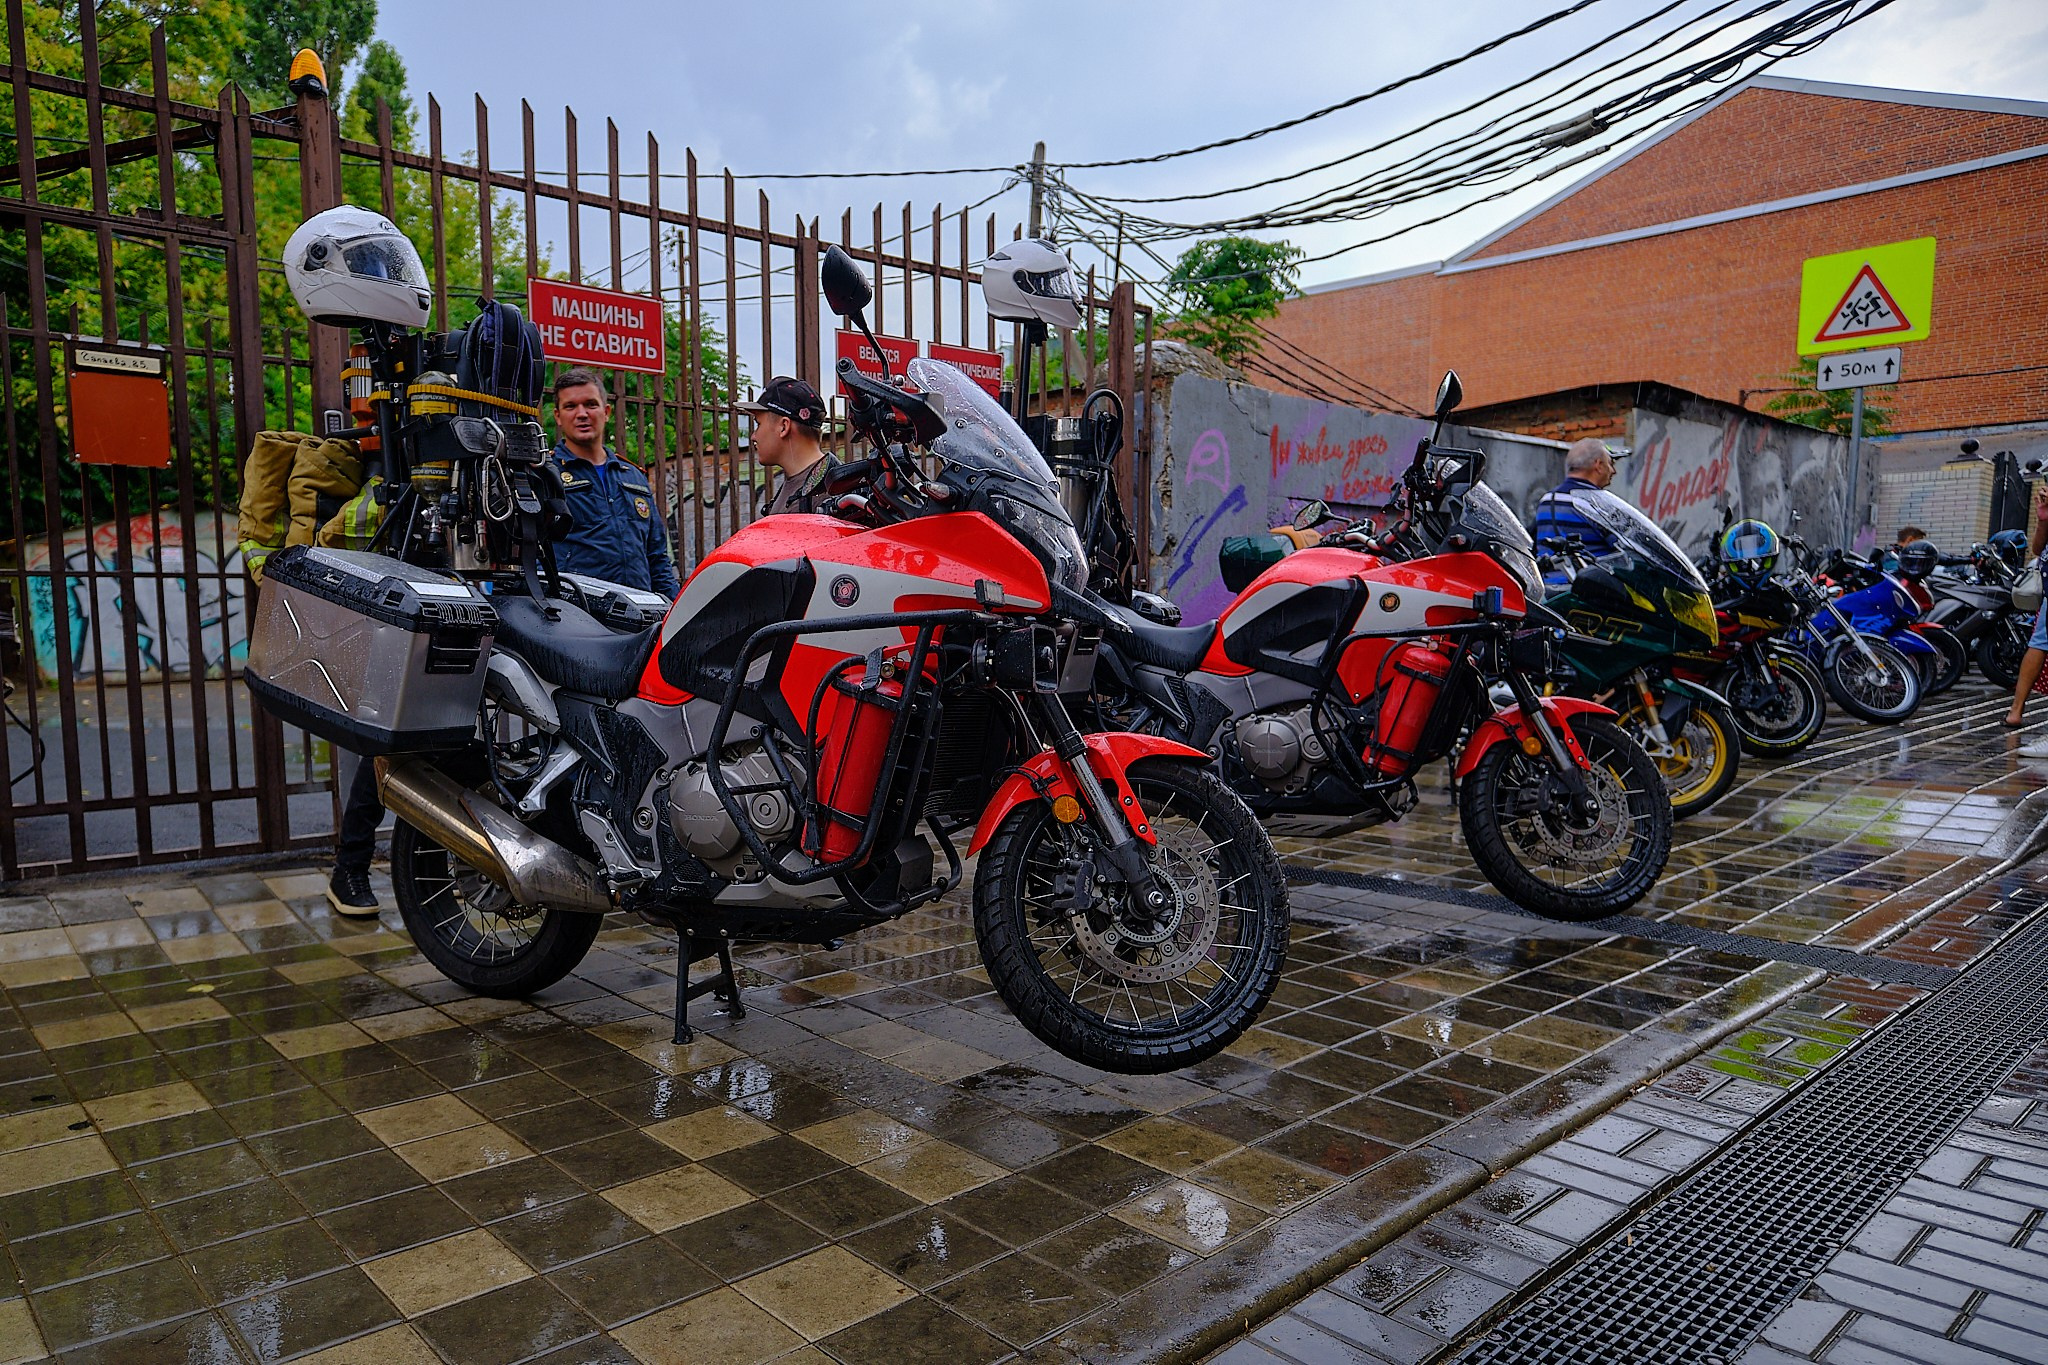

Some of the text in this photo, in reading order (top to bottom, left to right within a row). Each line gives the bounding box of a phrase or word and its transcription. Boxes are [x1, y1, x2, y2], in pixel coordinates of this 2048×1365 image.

[552, 296, 644, 330] МАШИНЫ
[539, 323, 658, 359] НЕ СТАВИТЬ
[859, 345, 900, 364] ВЕДТСЯ
[684, 813, 718, 822] HONDA
